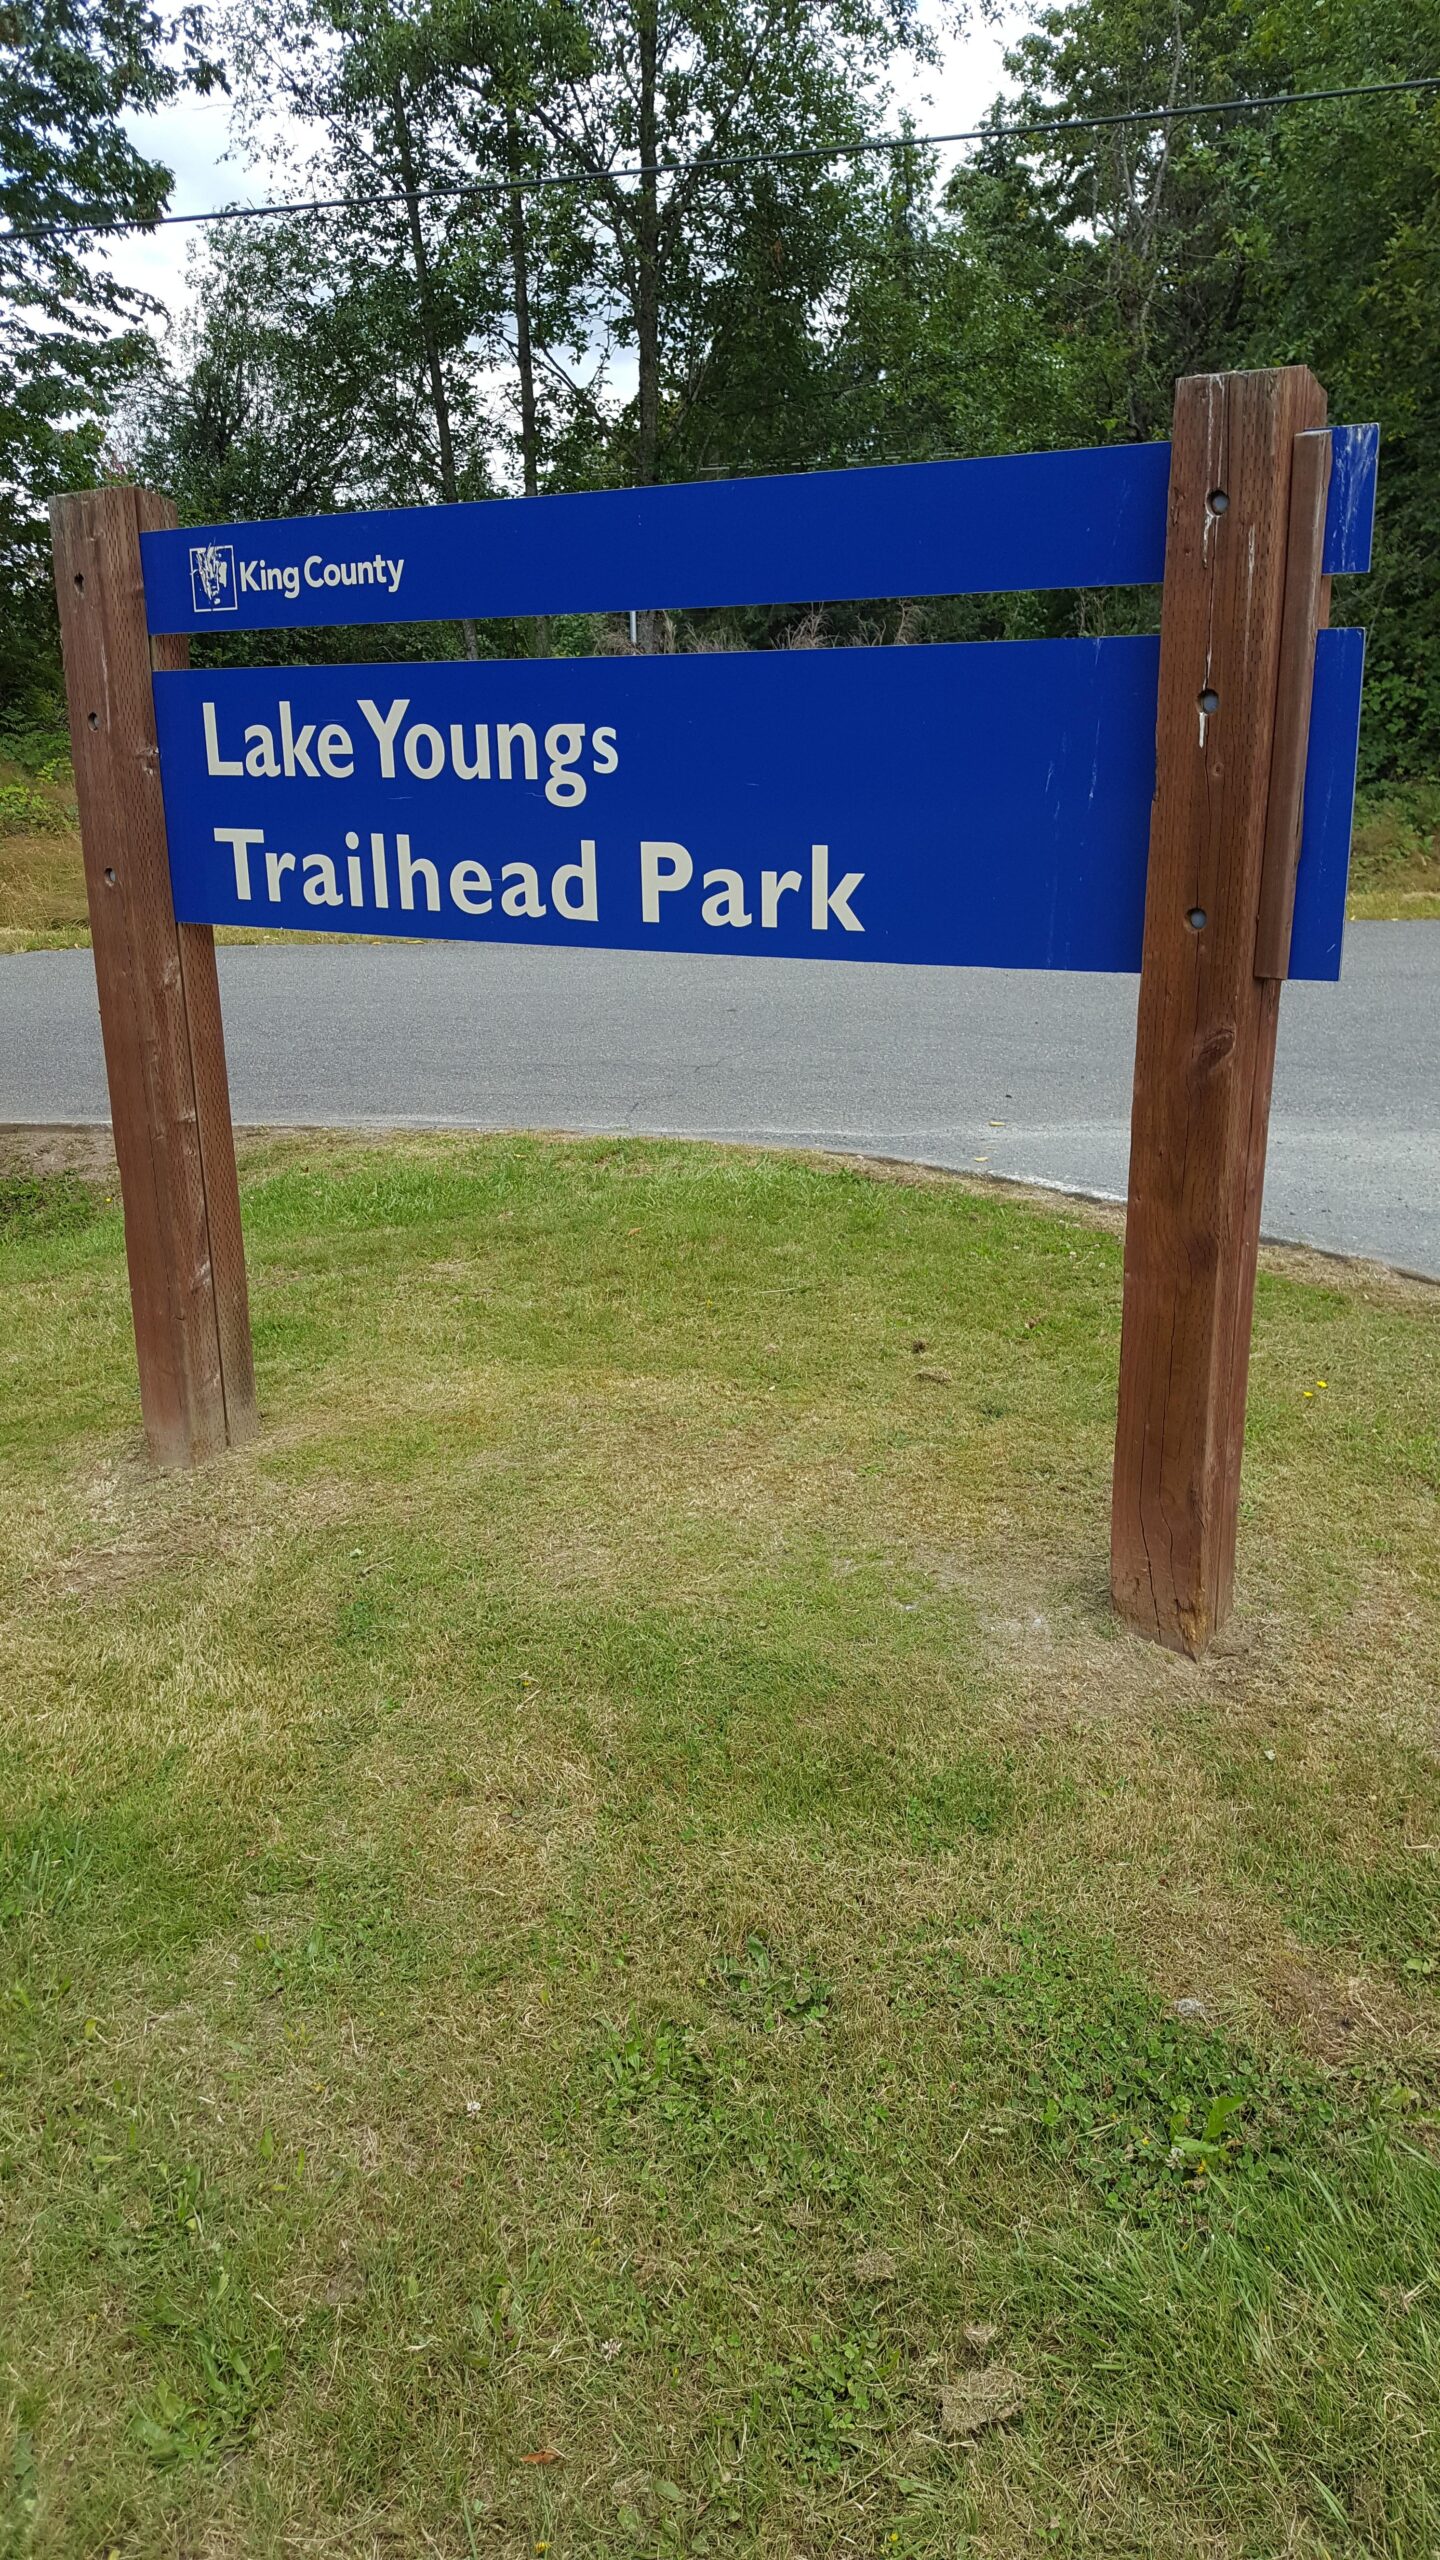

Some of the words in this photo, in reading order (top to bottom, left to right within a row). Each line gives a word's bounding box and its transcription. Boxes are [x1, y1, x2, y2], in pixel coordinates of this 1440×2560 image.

[239, 559, 300, 599] King
[303, 554, 405, 593] County
[202, 700, 354, 779] Lake
[356, 698, 619, 808] Youngs
[213, 827, 599, 922] Trailhead
[640, 841, 866, 932] Park
